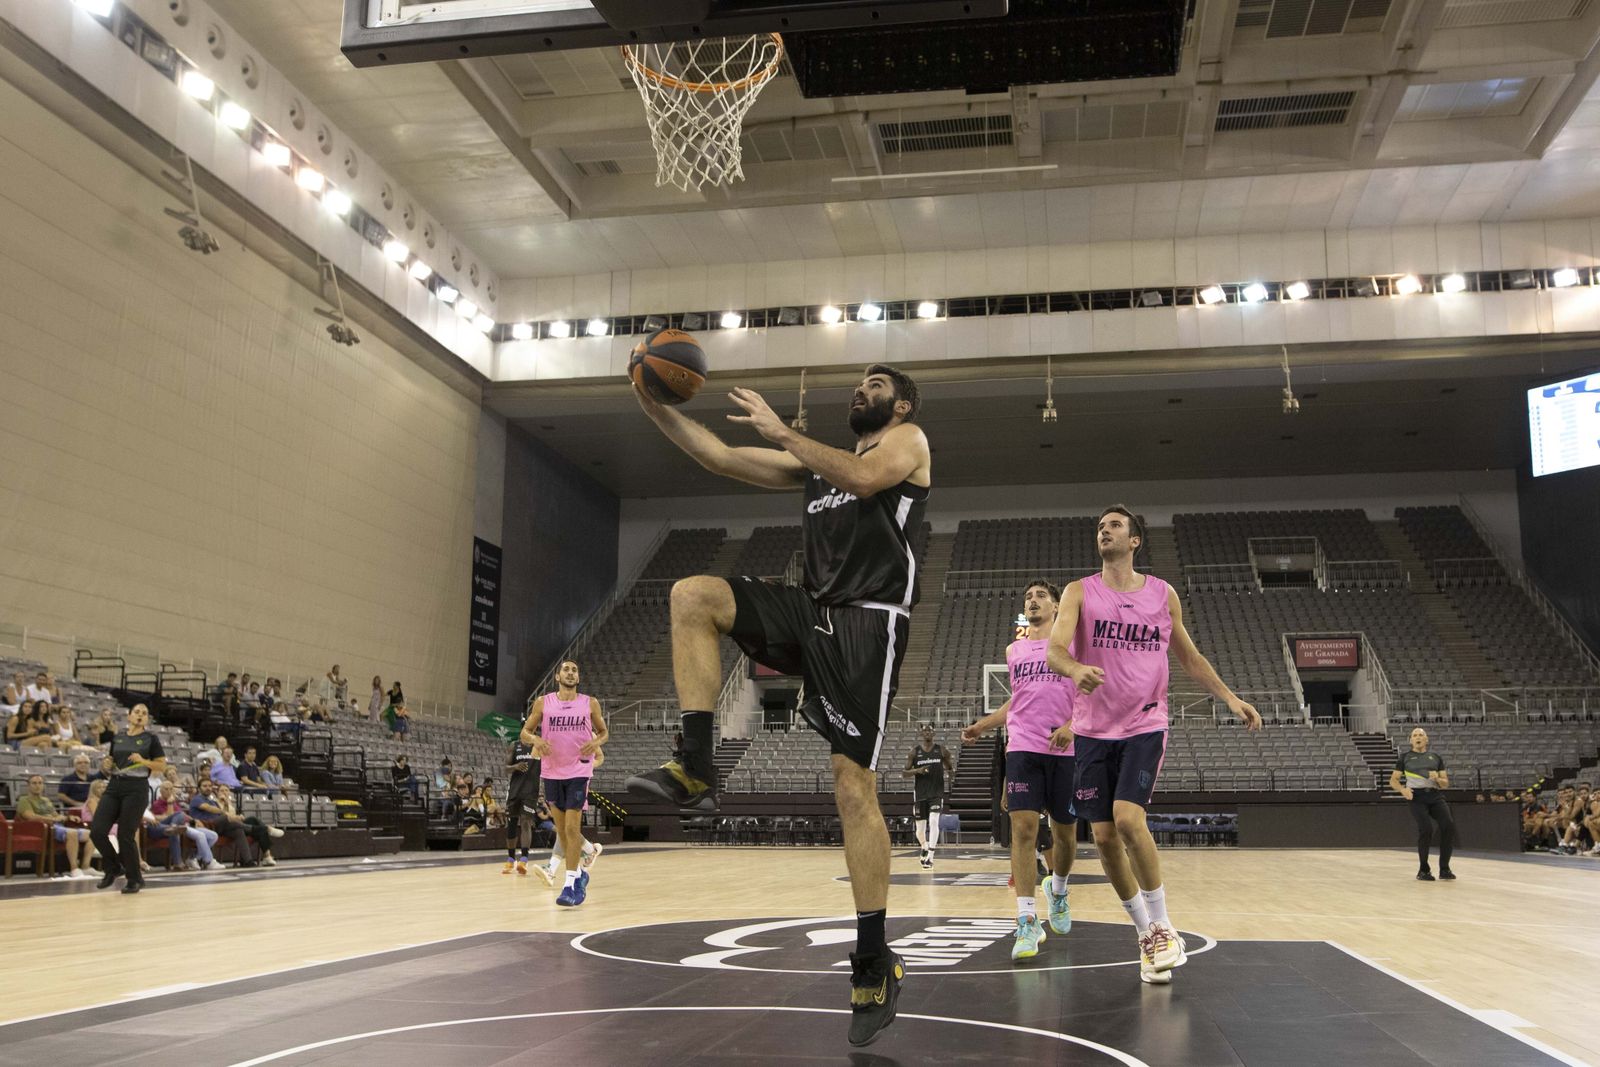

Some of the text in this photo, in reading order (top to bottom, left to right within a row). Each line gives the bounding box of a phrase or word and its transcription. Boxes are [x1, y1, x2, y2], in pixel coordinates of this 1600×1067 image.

[1092, 619, 1160, 642] MELILLA
[1092, 639, 1161, 652] BALONCESTO
[1315, 649, 1349, 657] GRANADA
[1013, 660, 1056, 680] MELILL
[549, 716, 586, 727] MELILLA
